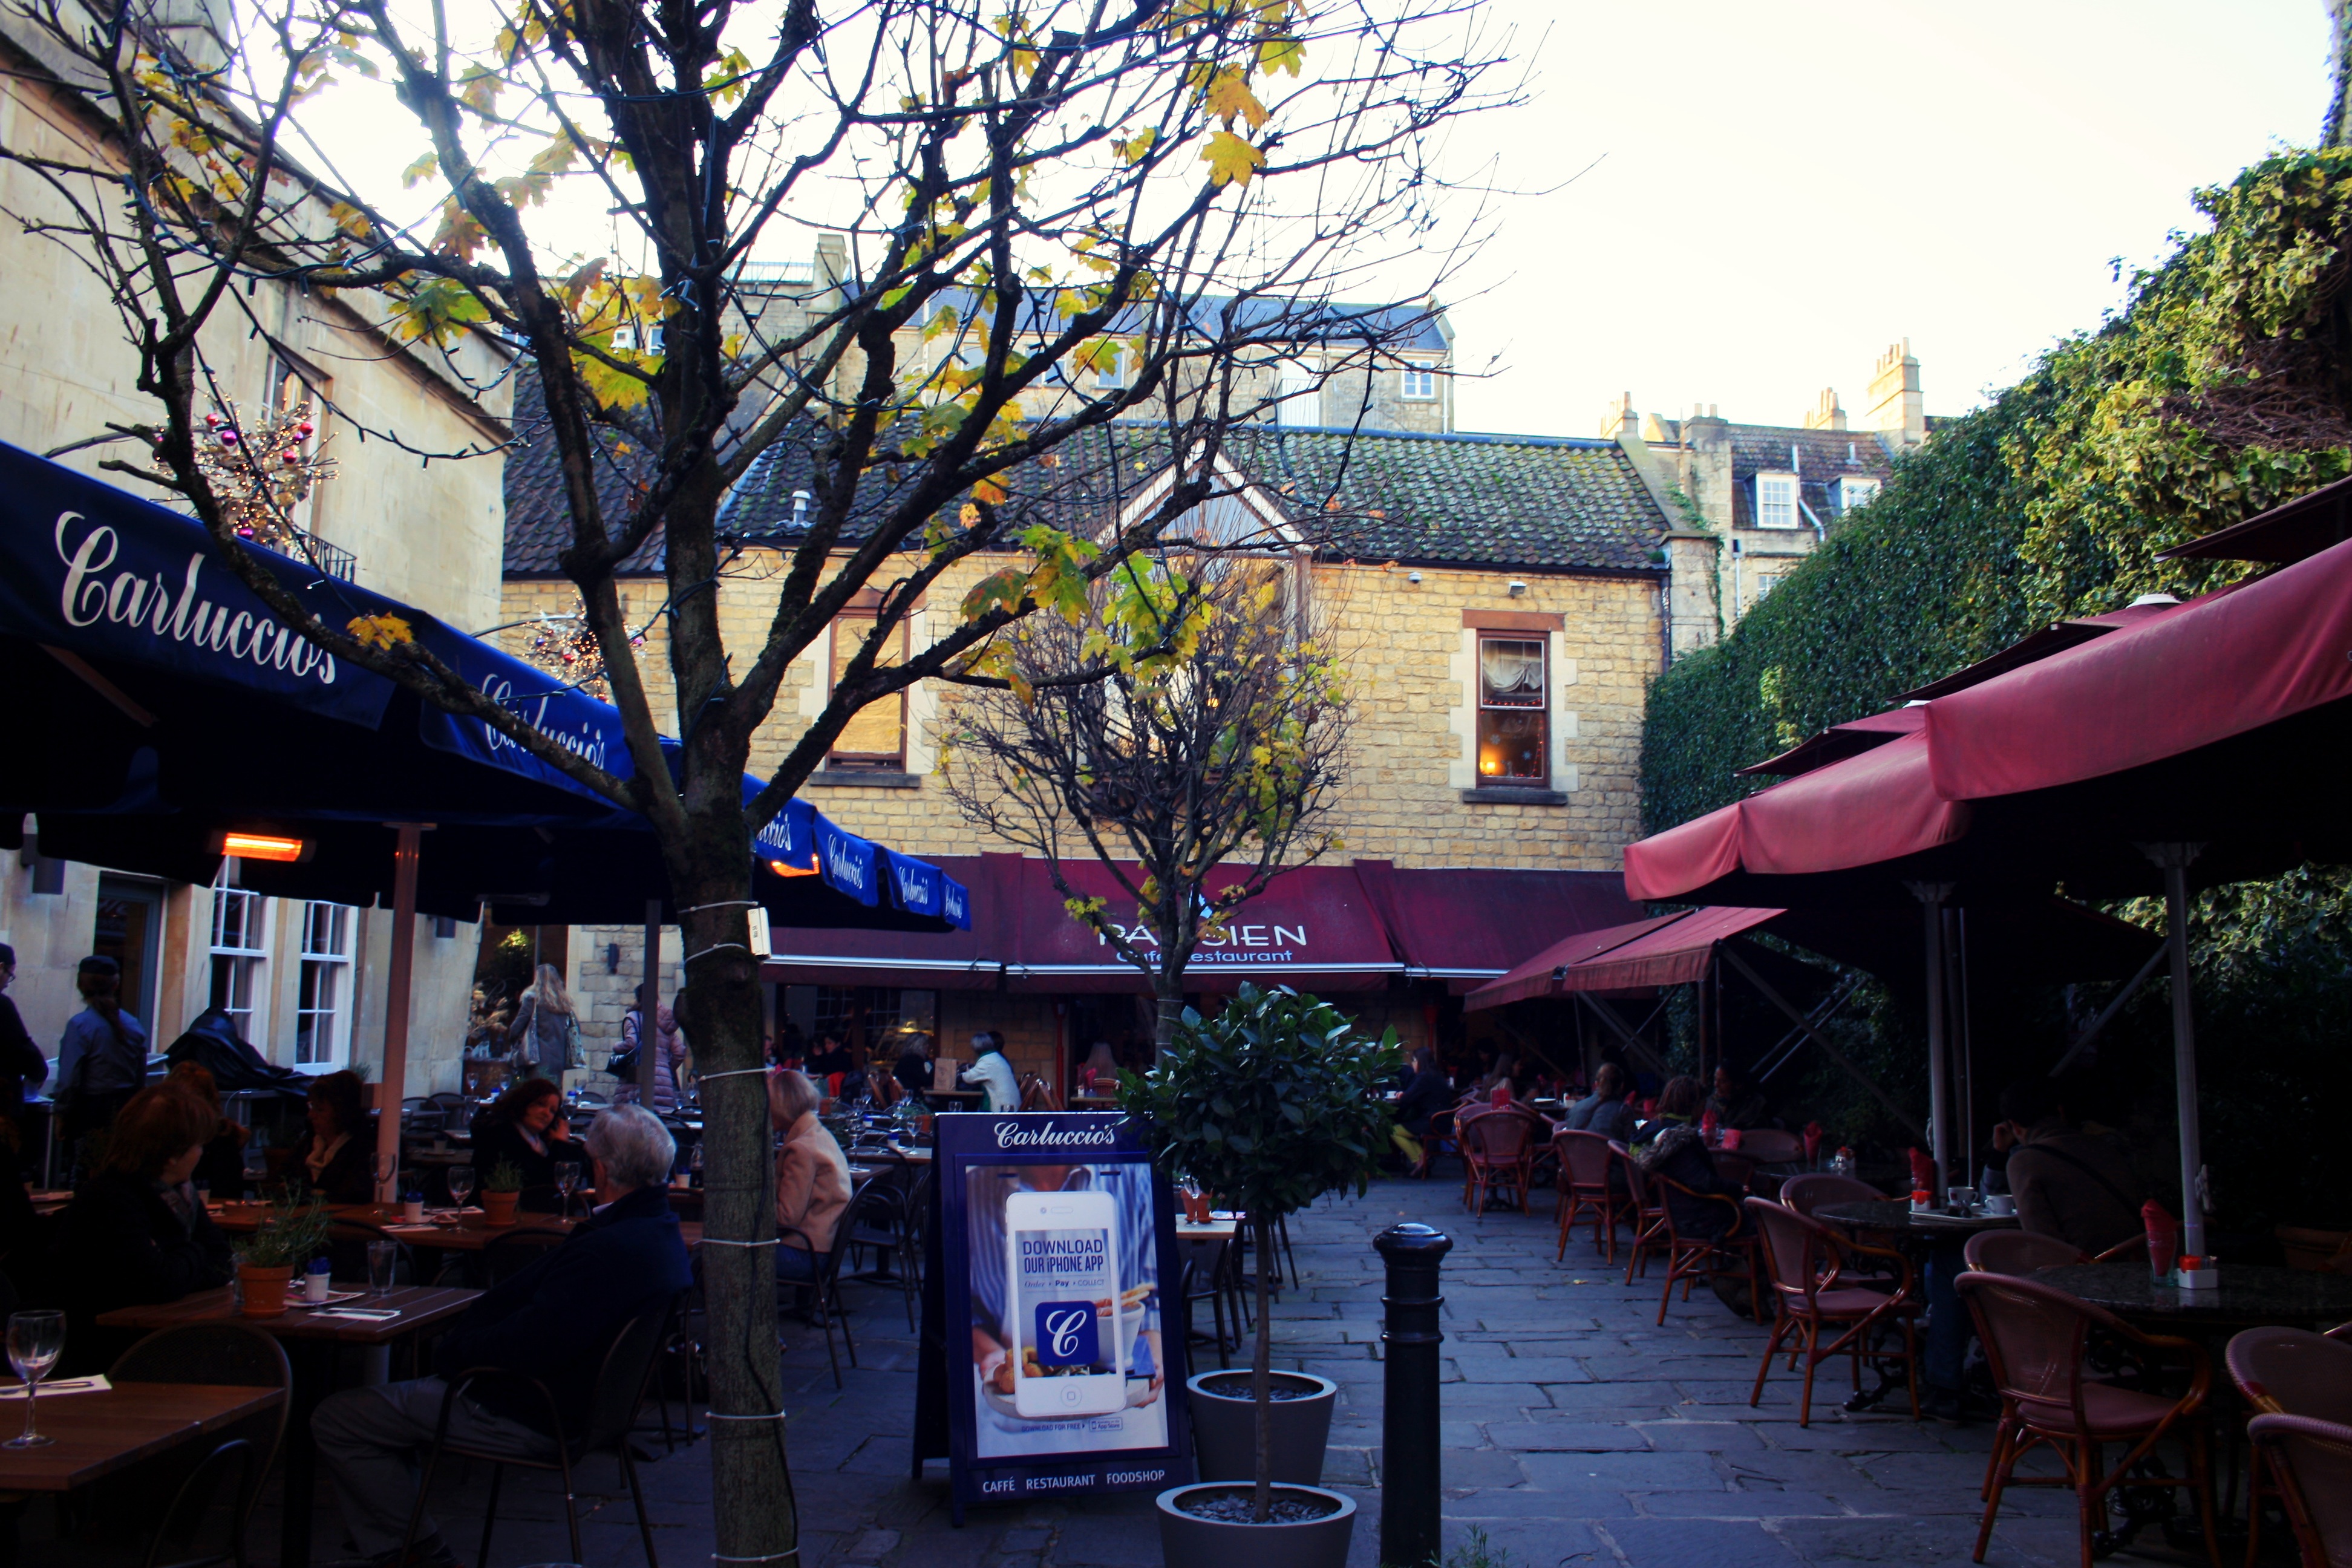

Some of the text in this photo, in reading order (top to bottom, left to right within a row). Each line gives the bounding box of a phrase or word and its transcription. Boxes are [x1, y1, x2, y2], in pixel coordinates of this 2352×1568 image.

[1099, 924, 1308, 947] PASIEN
[1187, 950, 1293, 962] estaurant
[994, 1120, 1116, 1148] Carluccio's
[1023, 1240, 1103, 1255] DOWNLOAD
[1024, 1255, 1103, 1273] OUR iPHONE APP
[982, 1469, 1165, 1493] CAFFÉ RESTAURANT FOODSHOP
